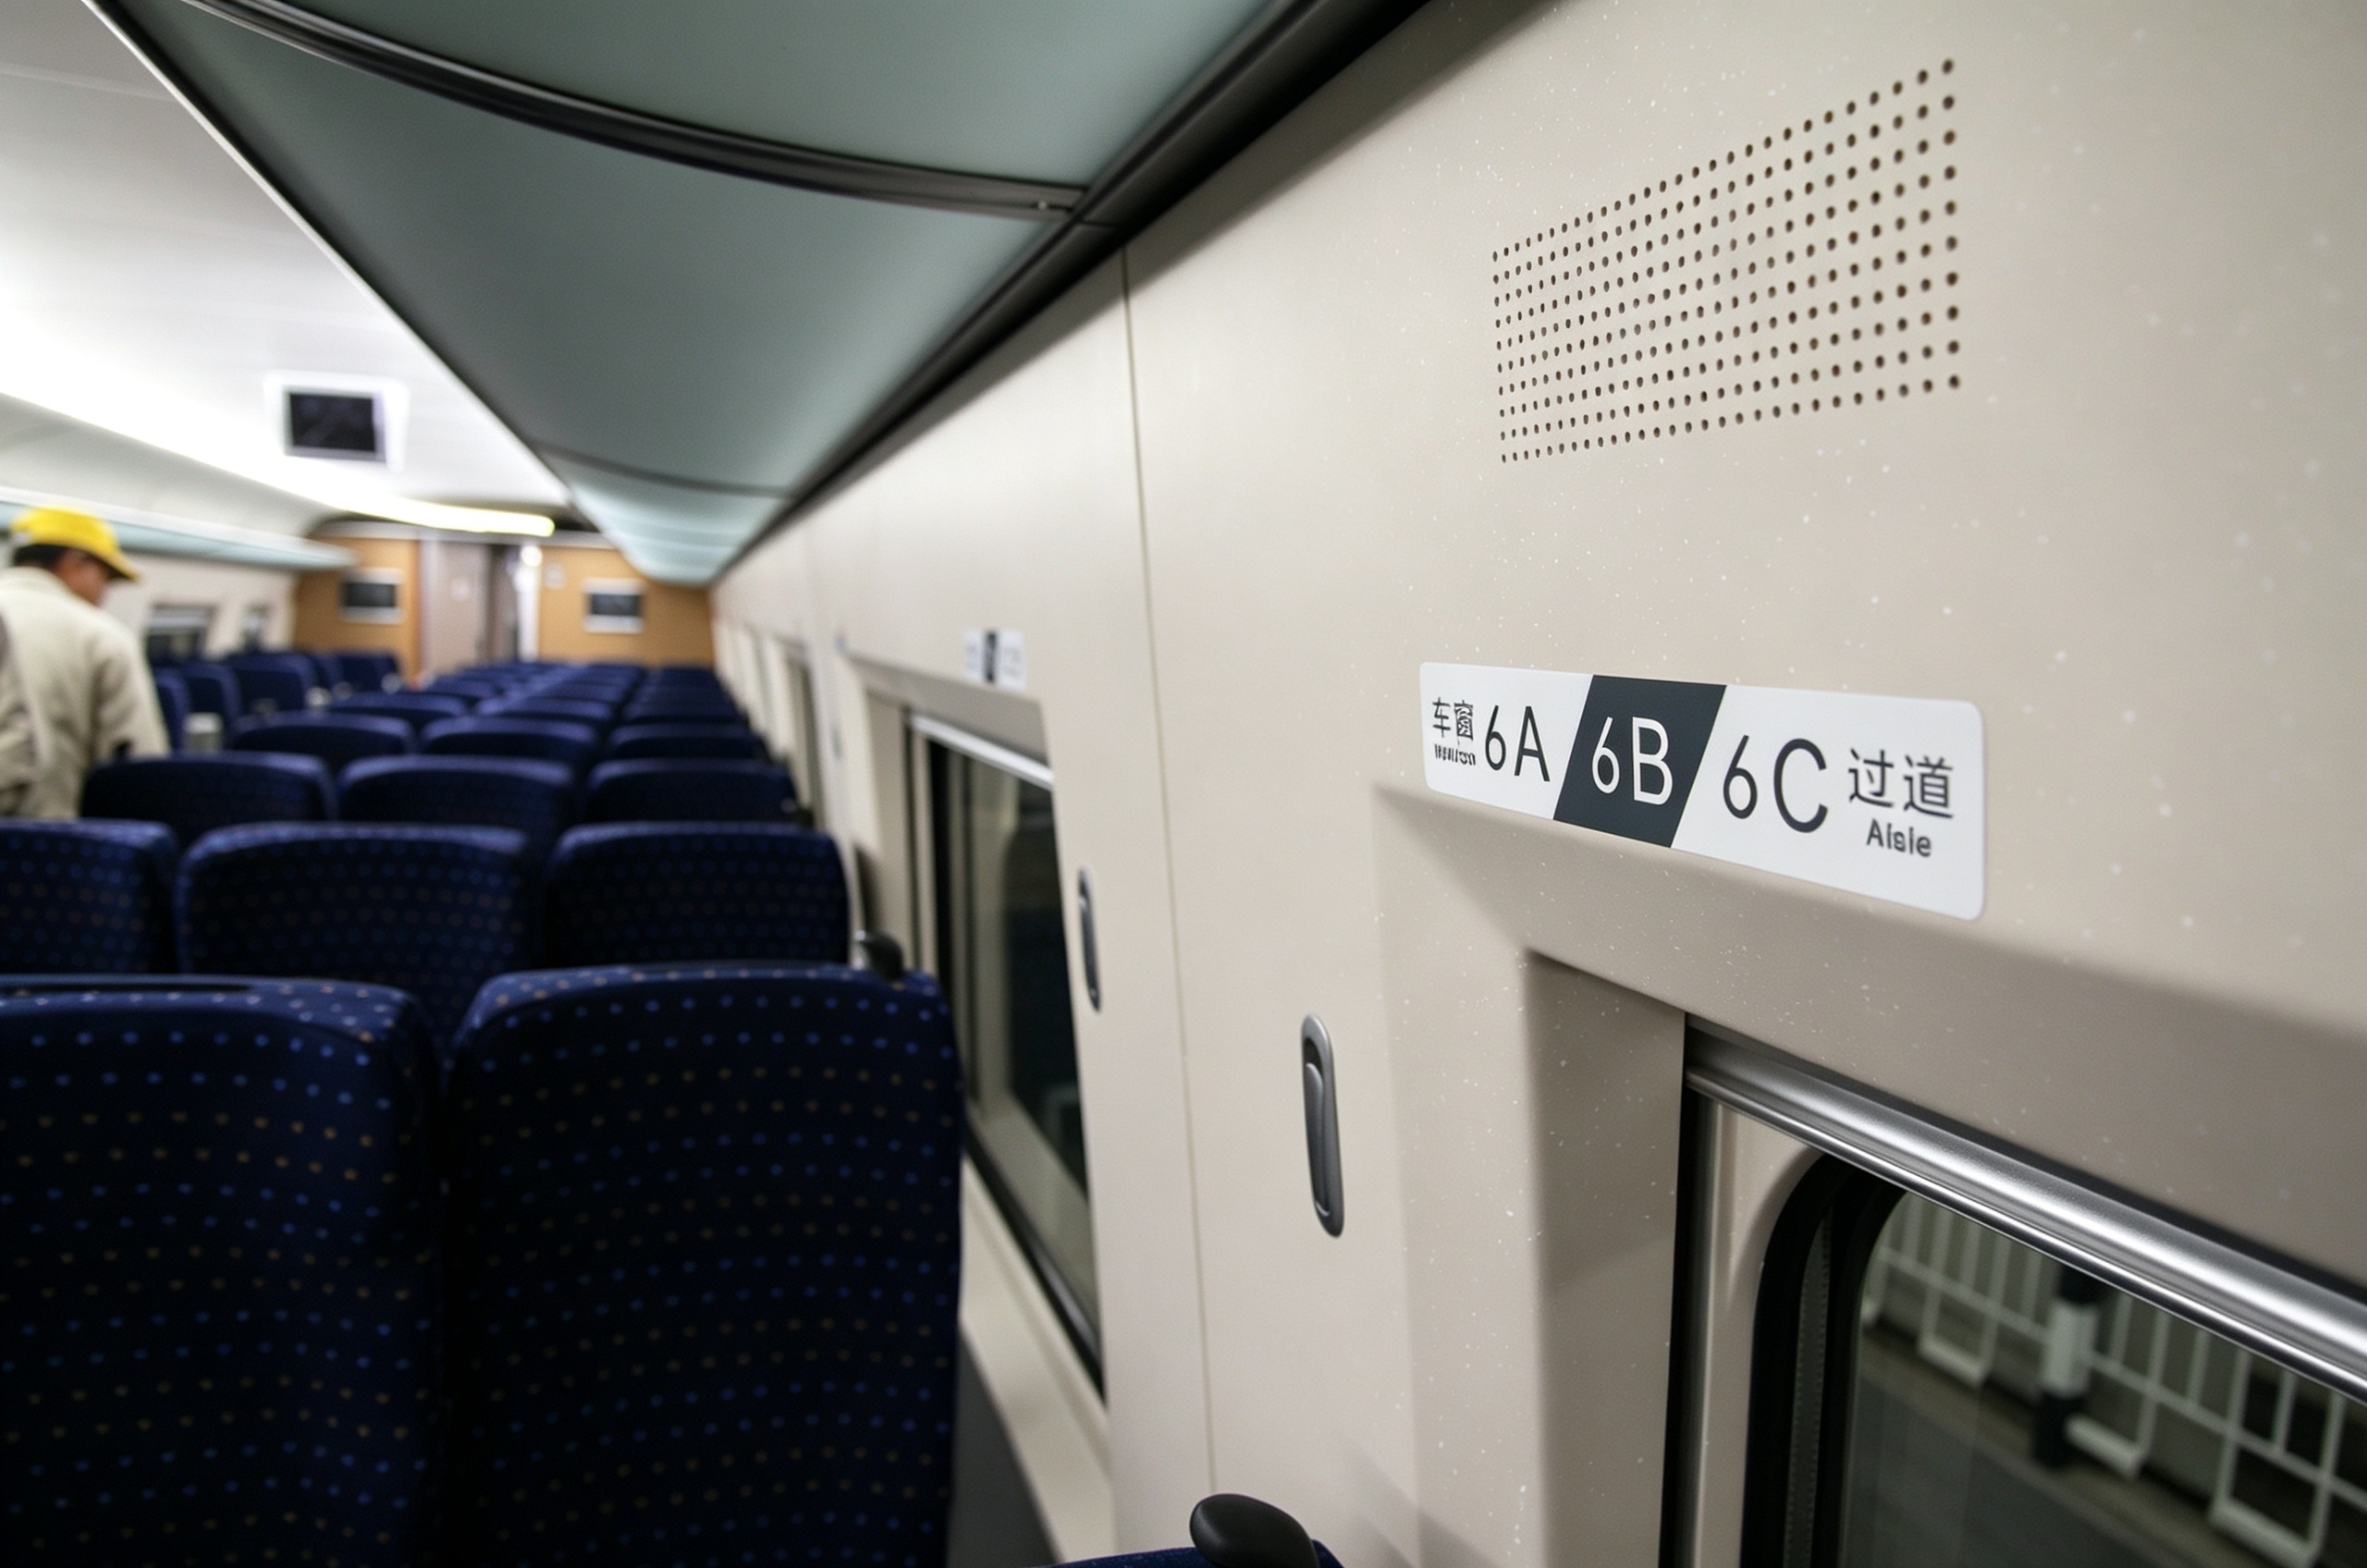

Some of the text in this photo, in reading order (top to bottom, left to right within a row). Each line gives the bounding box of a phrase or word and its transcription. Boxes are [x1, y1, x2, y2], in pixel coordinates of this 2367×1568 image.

[1484, 704, 1829, 834] 6A 6B 6C
[1847, 748, 1954, 819] 过道
